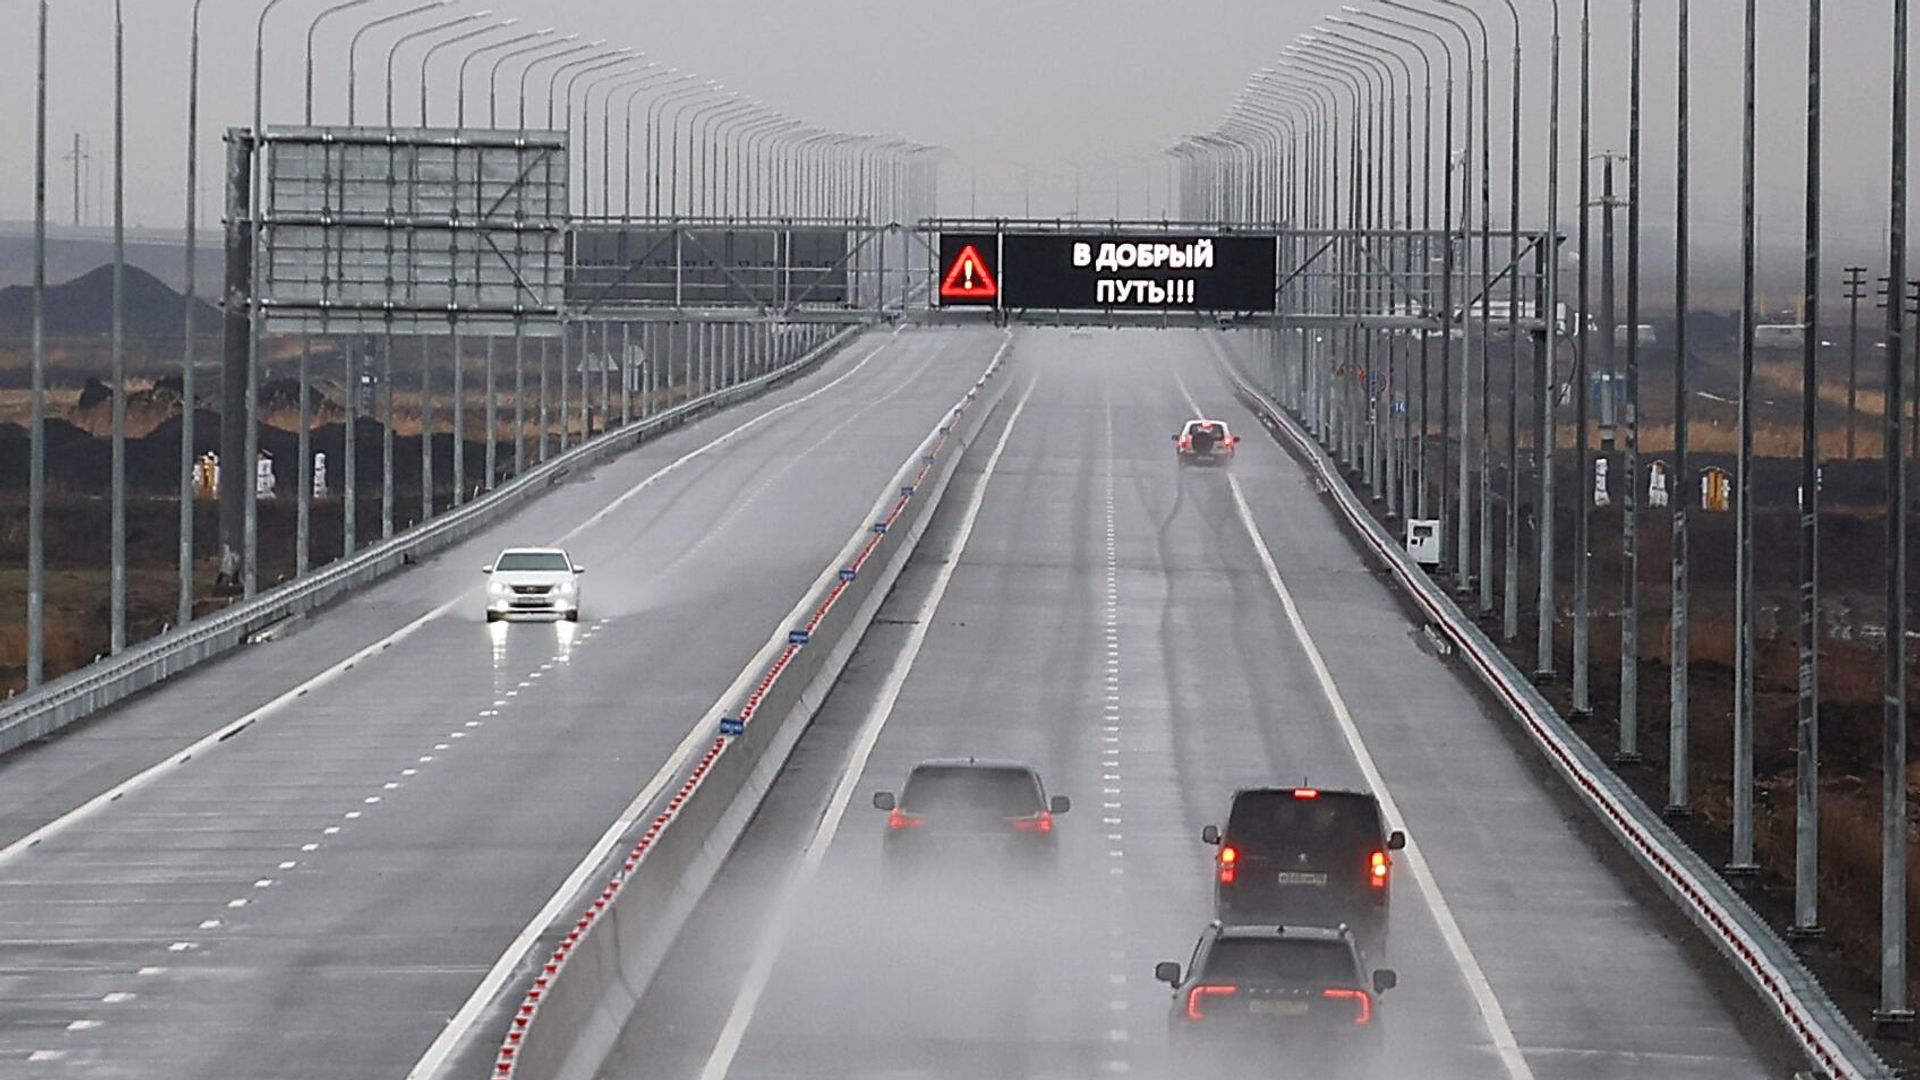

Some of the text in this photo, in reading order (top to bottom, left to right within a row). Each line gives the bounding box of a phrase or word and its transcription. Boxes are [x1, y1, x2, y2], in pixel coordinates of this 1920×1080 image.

[1073, 239, 1214, 272] В ДОБРЫЙ
[1096, 279, 1194, 304] ПУТЬ!!!
